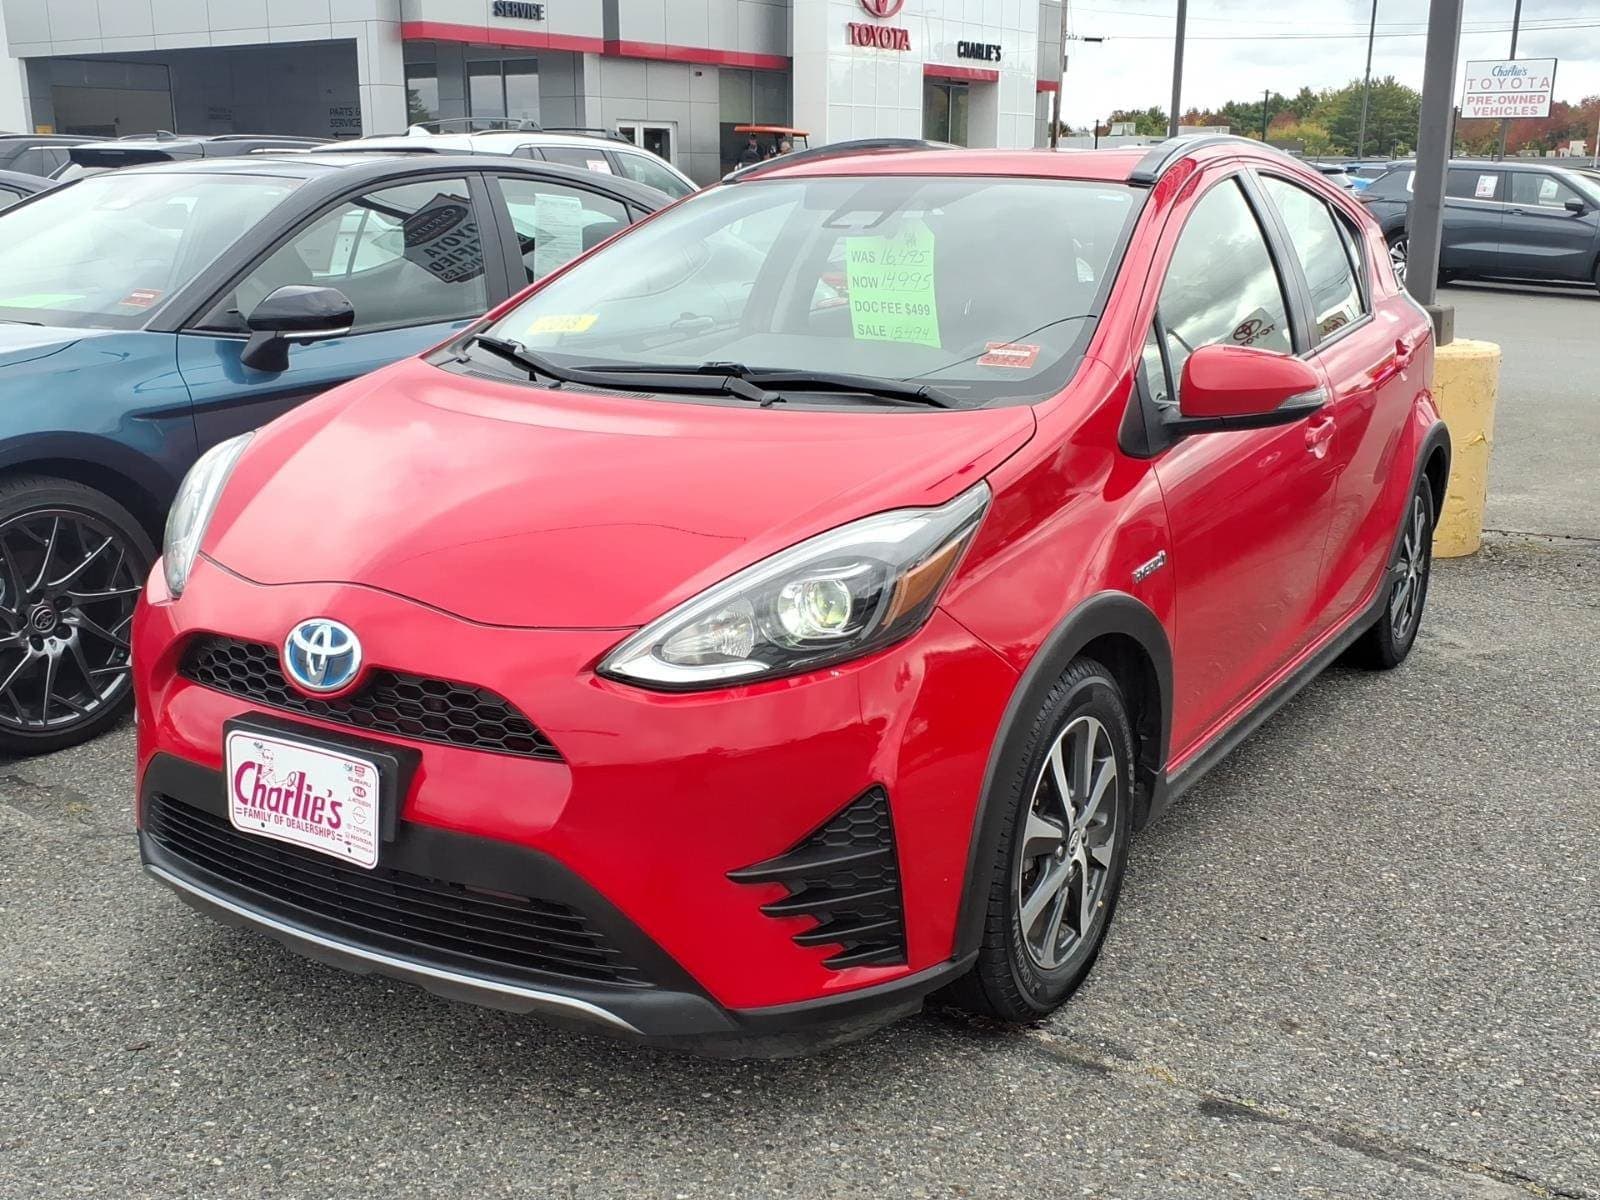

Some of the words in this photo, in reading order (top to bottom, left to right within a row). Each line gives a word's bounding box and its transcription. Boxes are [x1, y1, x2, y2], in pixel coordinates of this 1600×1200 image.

[493, 1, 545, 20] SERVICE
[848, 22, 912, 51] TOYOTA
[957, 40, 1002, 62] CHARLIE'S
[1491, 65, 1528, 77] Charlie's
[1467, 77, 1550, 90] TOYOTA
[1467, 95, 1546, 105] PRE-OWNED
[330, 107, 353, 116] PARTS
[1473, 106, 1538, 116] VEHICLES
[330, 118, 361, 128] SERVICE
[850, 250, 876, 263] WAS
[852, 276, 879, 289] NOW
[854, 300, 879, 313] DOC
[880, 302, 902, 314] FEE
[904, 303, 931, 316] $499
[858, 323, 887, 337] SALE
[234, 760, 343, 830] Charlie's
[243, 808, 272, 823] FAMILY
[273, 814, 284, 826] OF
[286, 816, 337, 841] DEALERSHIPS
